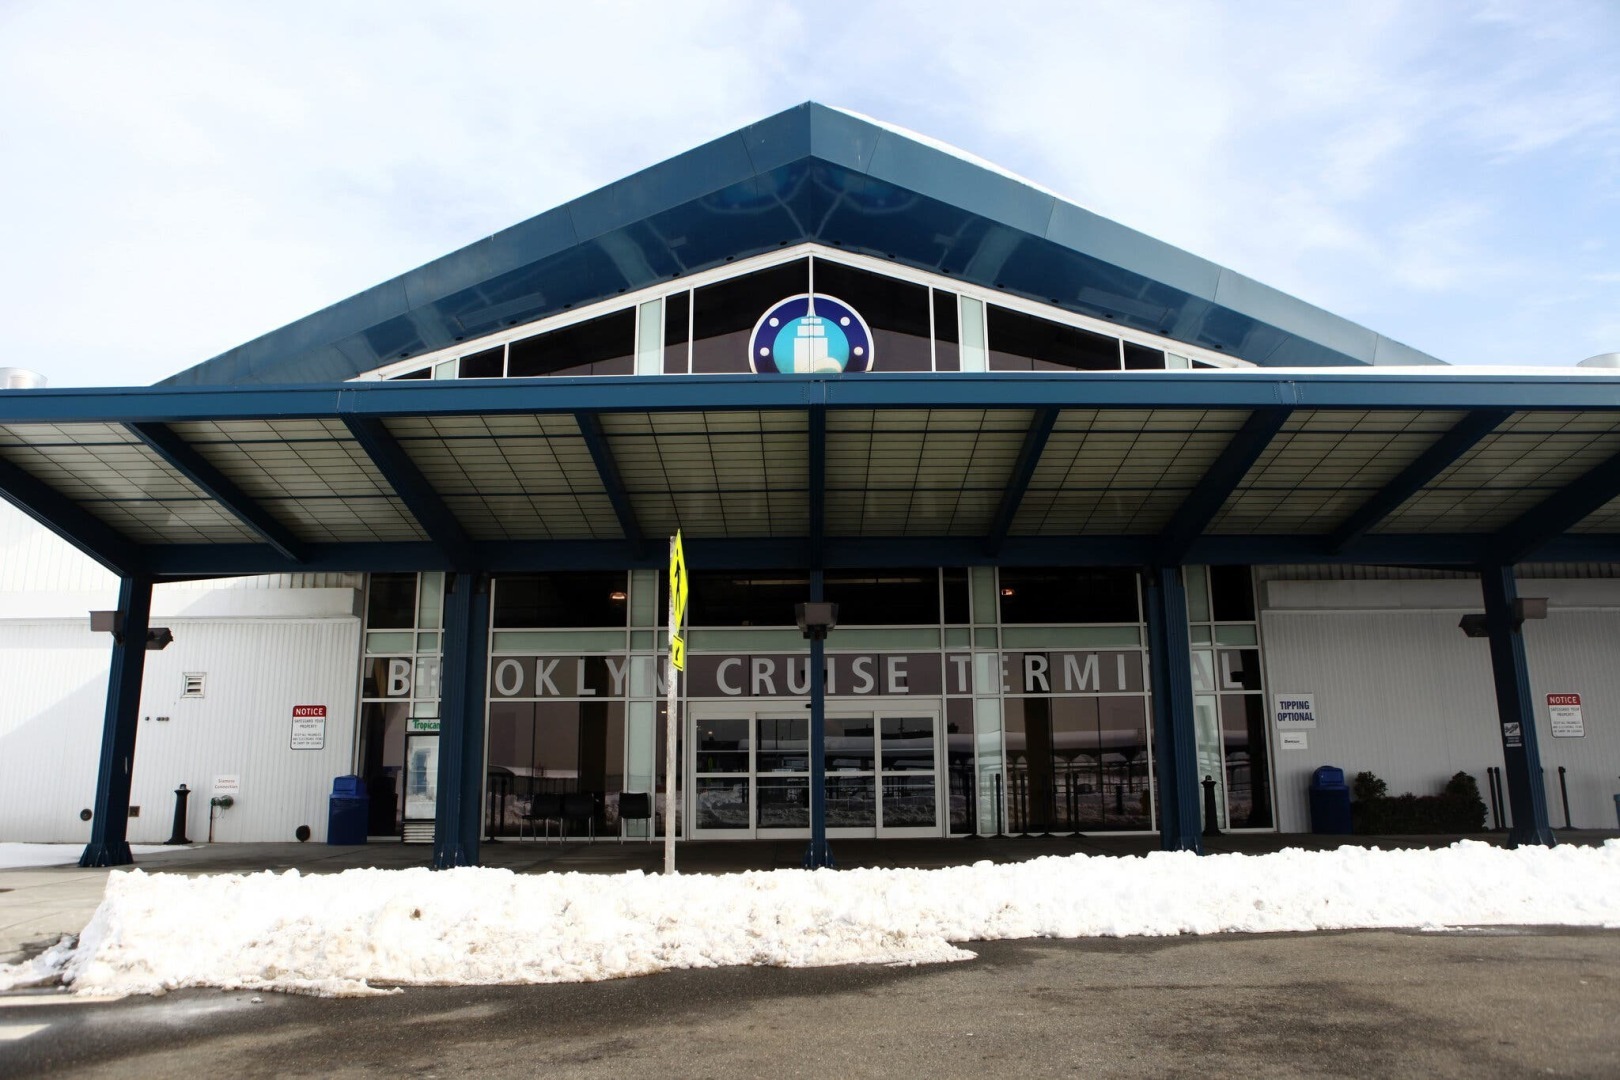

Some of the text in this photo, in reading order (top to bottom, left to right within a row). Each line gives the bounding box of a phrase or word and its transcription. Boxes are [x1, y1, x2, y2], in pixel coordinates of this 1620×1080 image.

[716, 656, 909, 695] CRUISE
[950, 651, 1243, 692] TERMIAL
[1550, 696, 1577, 704] NOTICE
[1280, 701, 1310, 710] TIPPING
[295, 707, 324, 716] NOTICE
[1277, 712, 1314, 721] OPTIONAL
